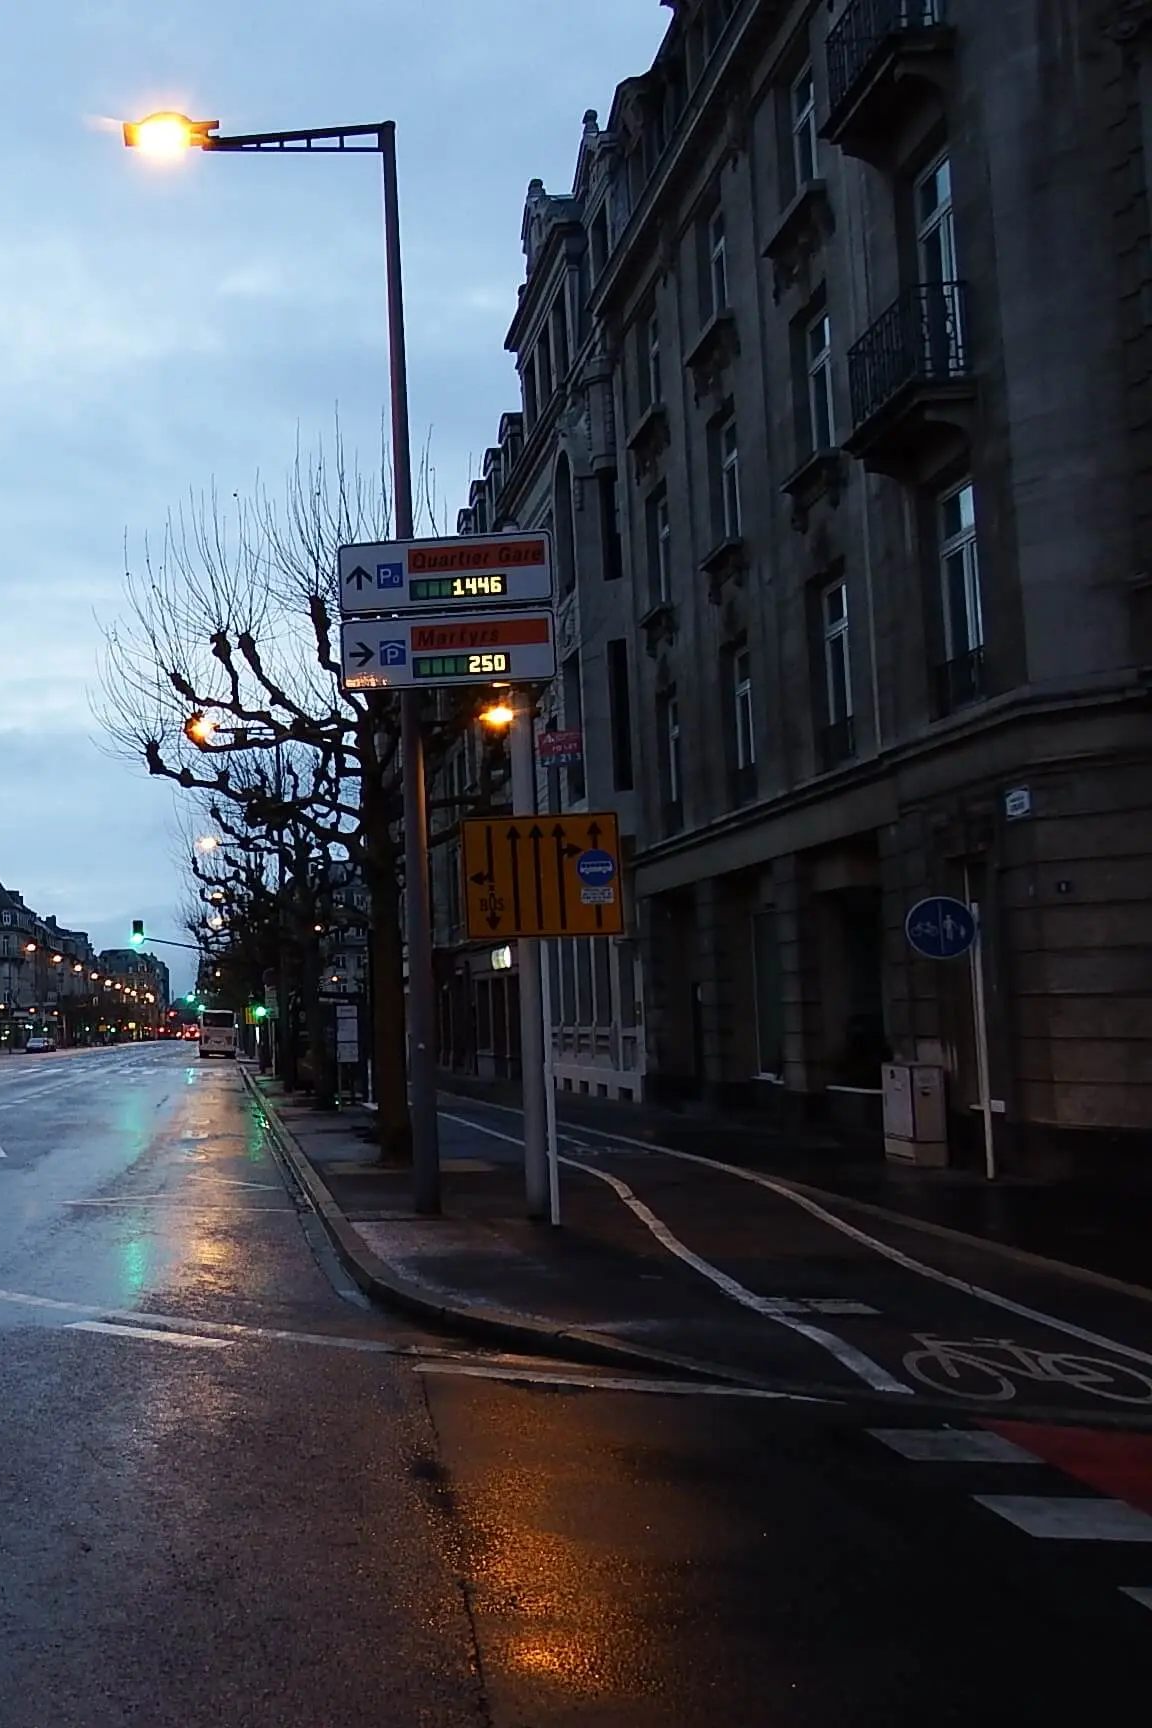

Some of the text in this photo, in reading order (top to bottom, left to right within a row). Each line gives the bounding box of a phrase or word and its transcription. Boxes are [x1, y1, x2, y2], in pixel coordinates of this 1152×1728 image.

[411, 545, 543, 570] Quartier Gare
[452, 576, 502, 596] 1446
[417, 628, 500, 647] Martyrs
[386, 648, 399, 665] P
[468, 654, 506, 673] 250
[479, 896, 506, 912] BUS
